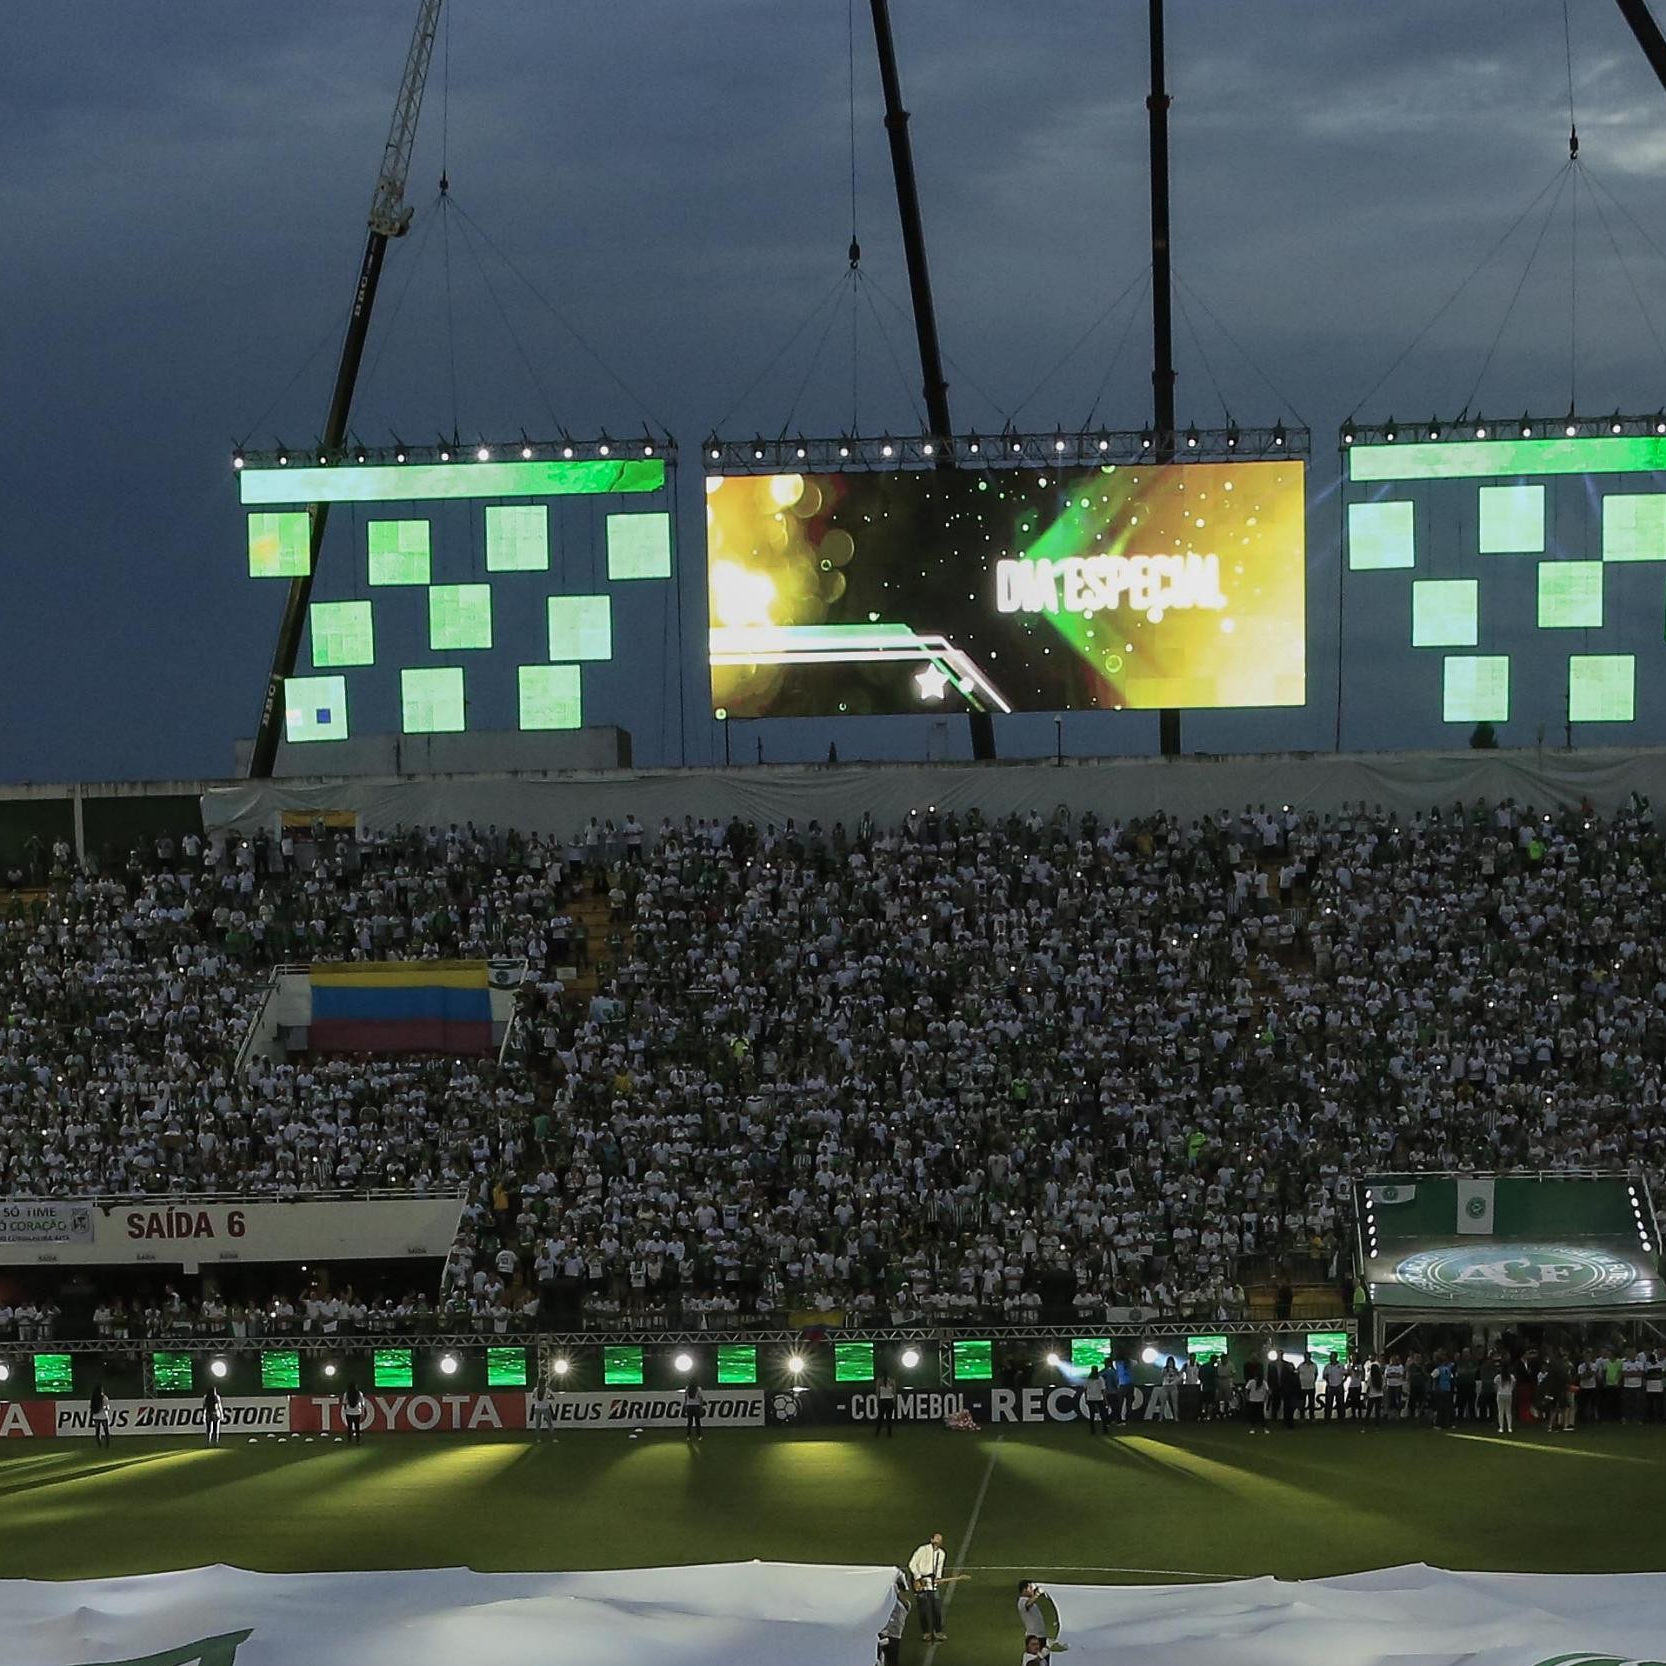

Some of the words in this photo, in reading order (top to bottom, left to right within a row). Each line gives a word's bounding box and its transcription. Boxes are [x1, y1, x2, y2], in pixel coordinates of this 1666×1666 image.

[27, 1207, 56, 1217] TIME
[128, 1207, 215, 1239] SAÍDA
[227, 1211, 245, 1237] 6
